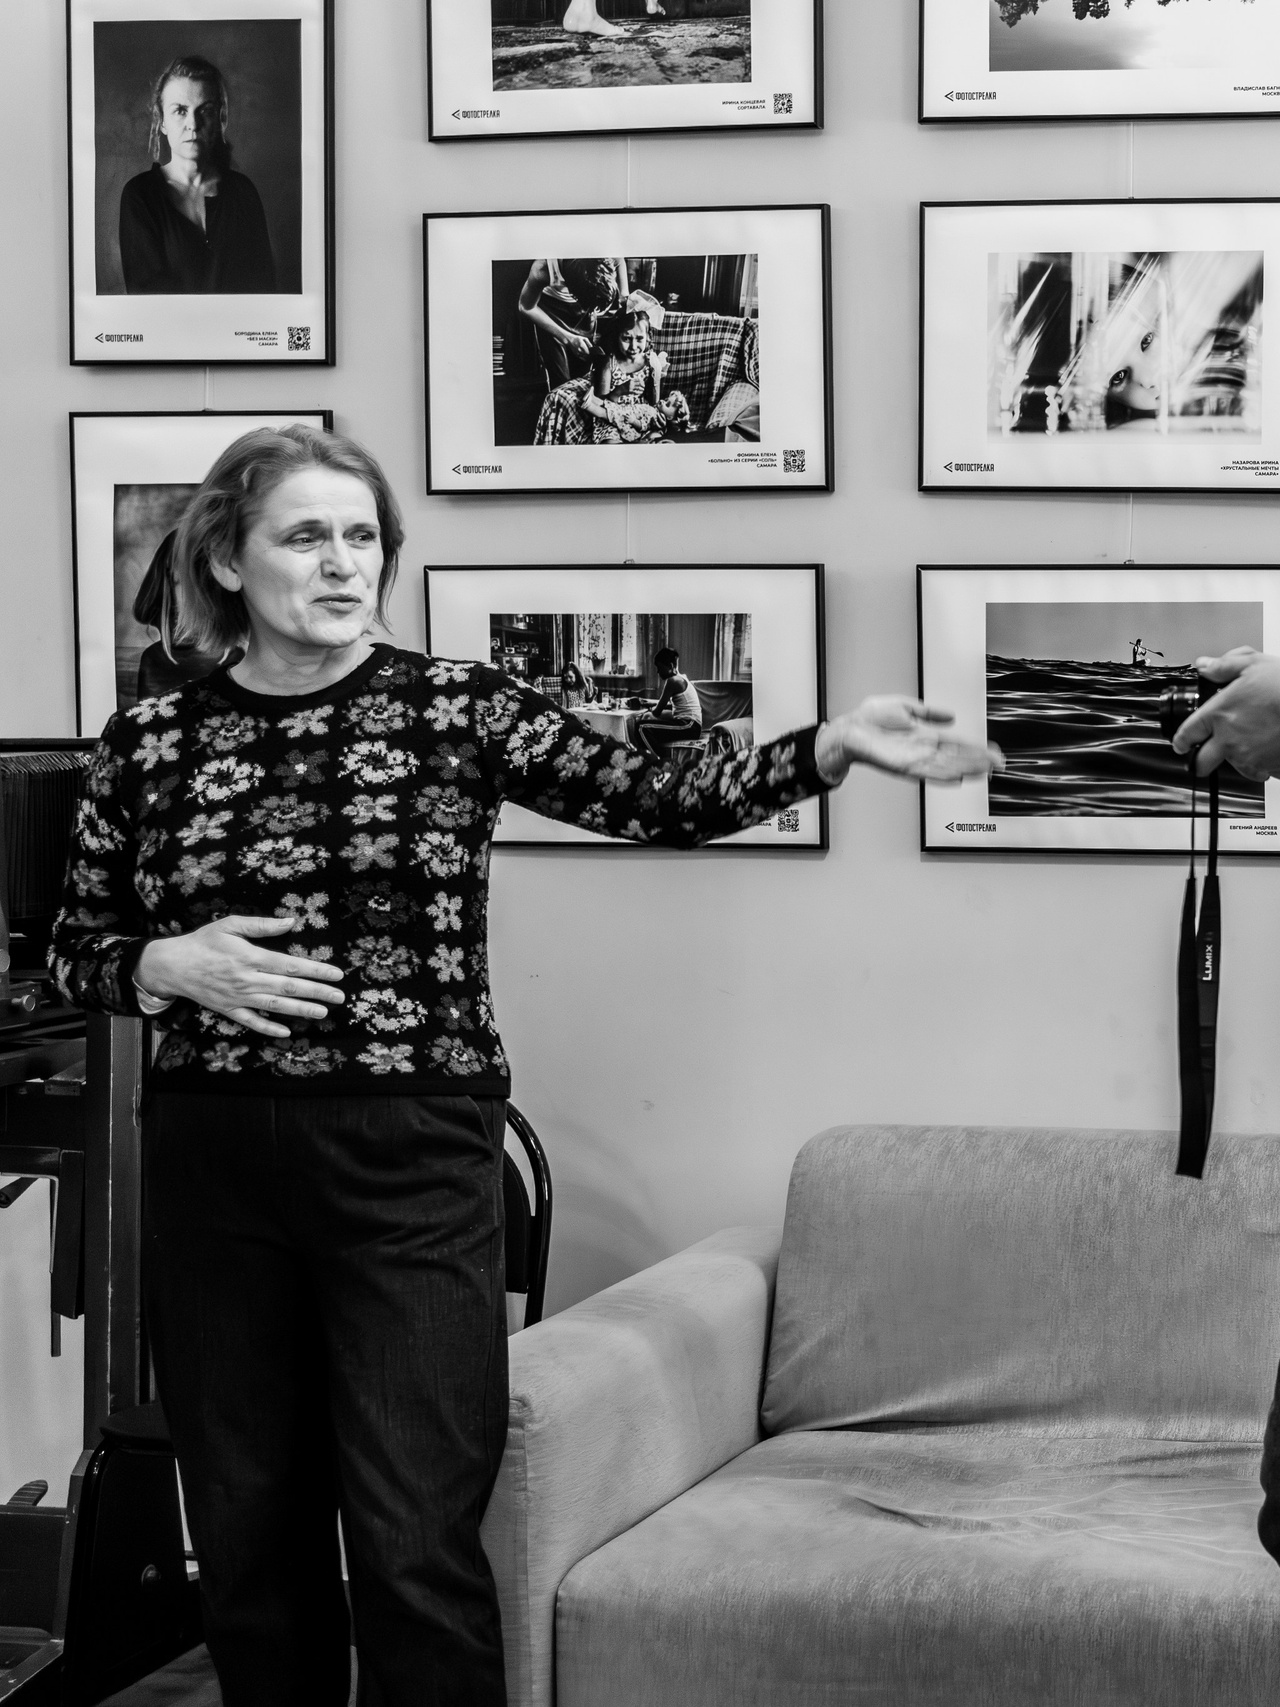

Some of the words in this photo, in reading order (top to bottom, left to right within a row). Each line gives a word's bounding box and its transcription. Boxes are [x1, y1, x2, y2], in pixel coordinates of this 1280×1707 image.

[955, 91, 997, 101] ФОТОСТРЕЛКА
[461, 110, 501, 118] ФОТОСТРЕЛКА
[104, 333, 144, 343] ФОТОСТРЕЛКА
[462, 465, 503, 474] ФОТОСТРЕЛКА
[954, 463, 995, 472] ФОТОСТРЕЛКА
[955, 823, 997, 832] ФОТОСТРЕЛКА
[1202, 944, 1213, 981] LUMIX
